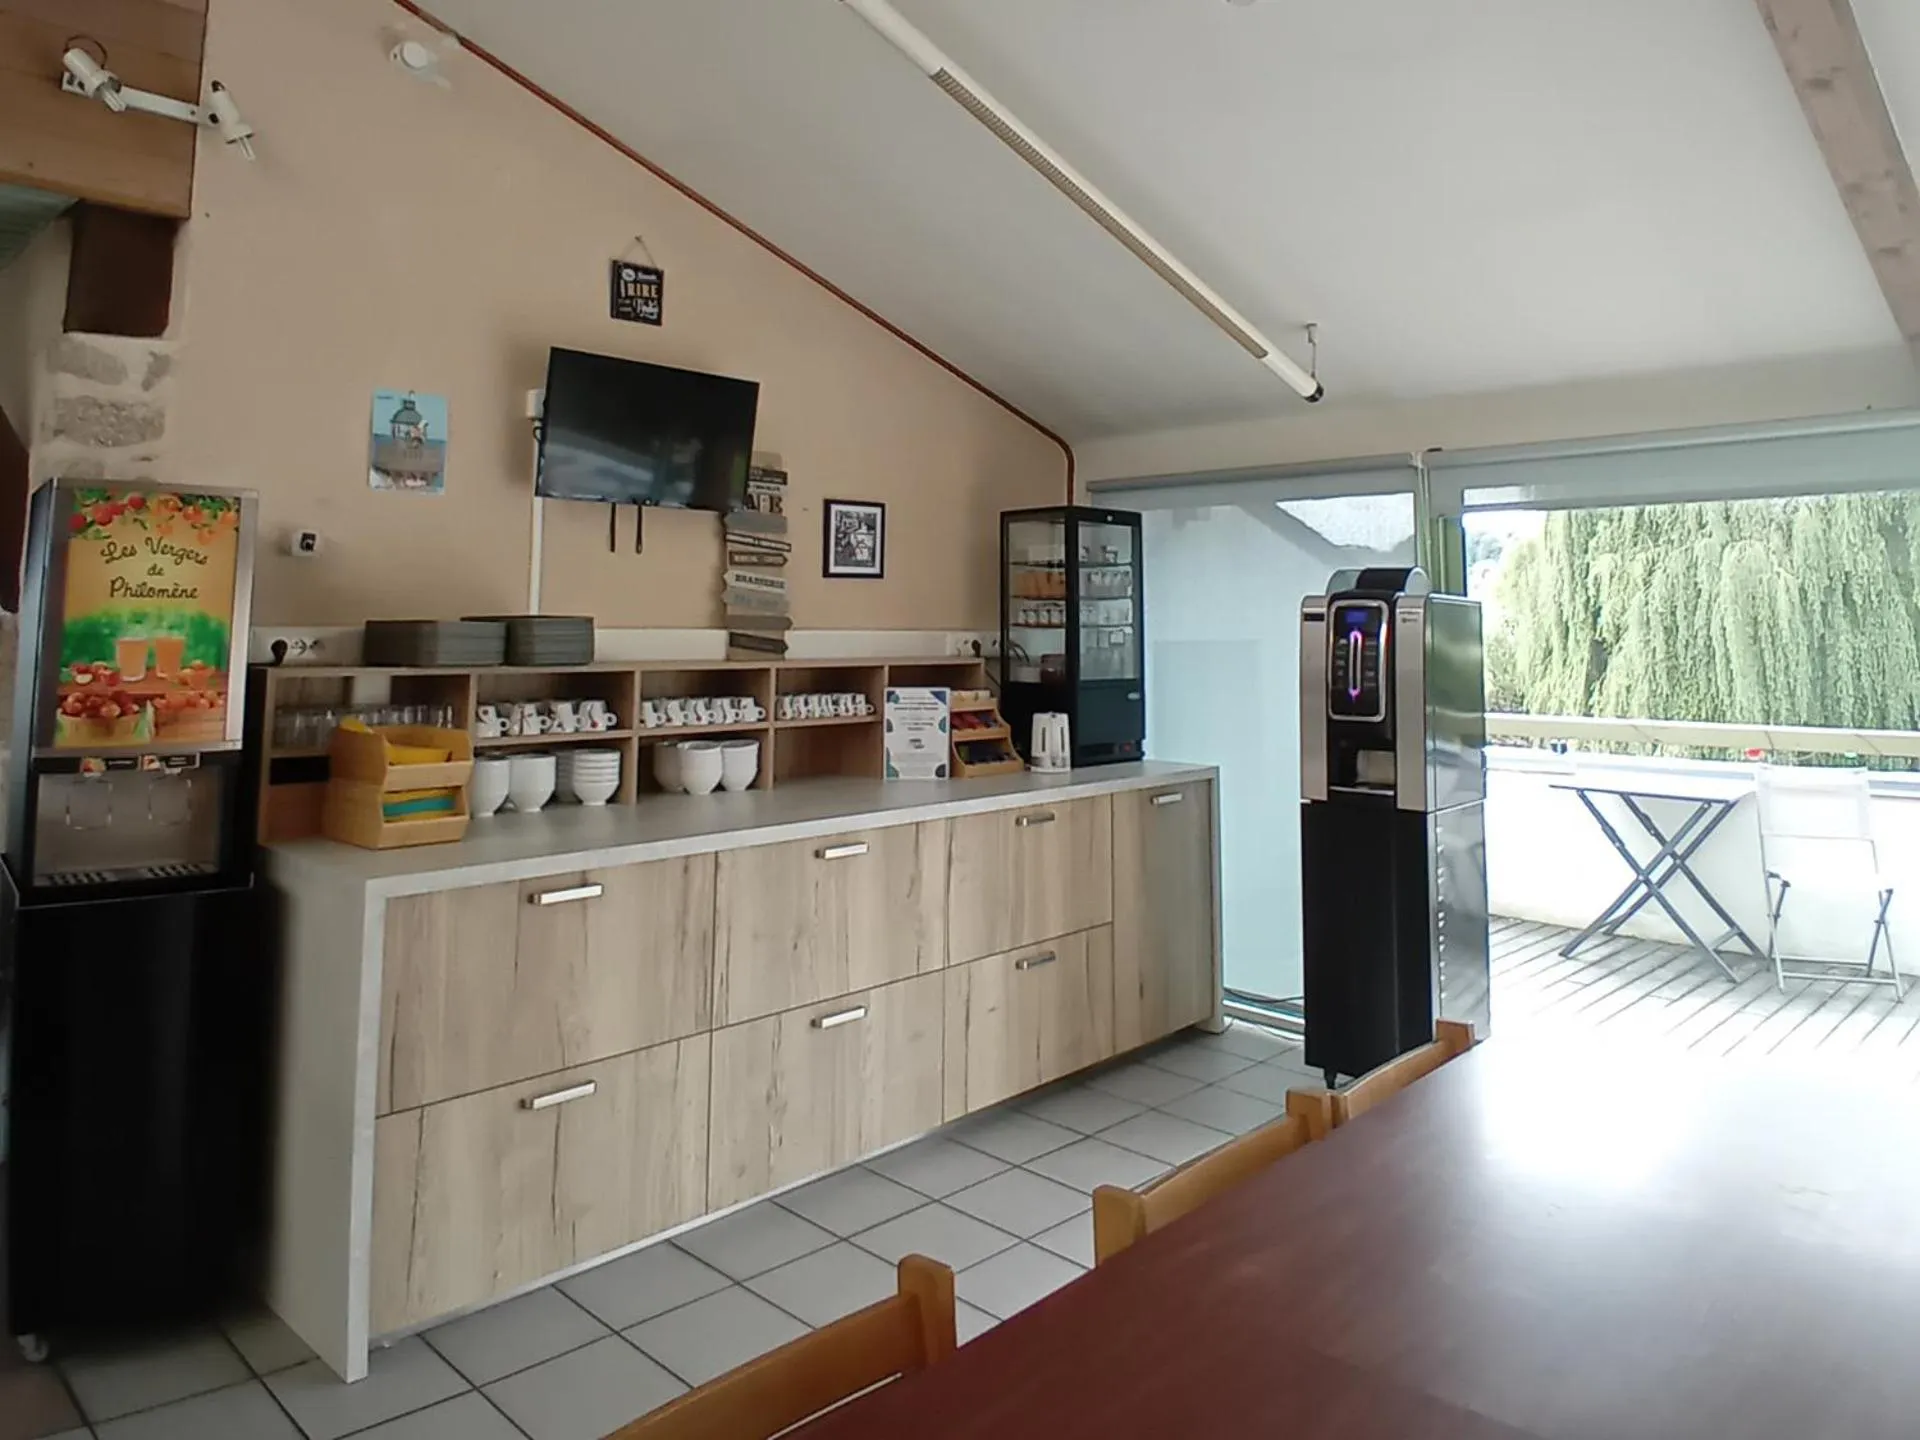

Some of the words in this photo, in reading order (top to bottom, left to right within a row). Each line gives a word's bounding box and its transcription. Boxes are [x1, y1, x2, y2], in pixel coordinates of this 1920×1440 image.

[744, 493, 784, 514] AFE
[100, 541, 137, 564] Les
[144, 536, 208, 565] Vergers
[147, 563, 165, 576] de
[110, 576, 199, 599] Philomène
